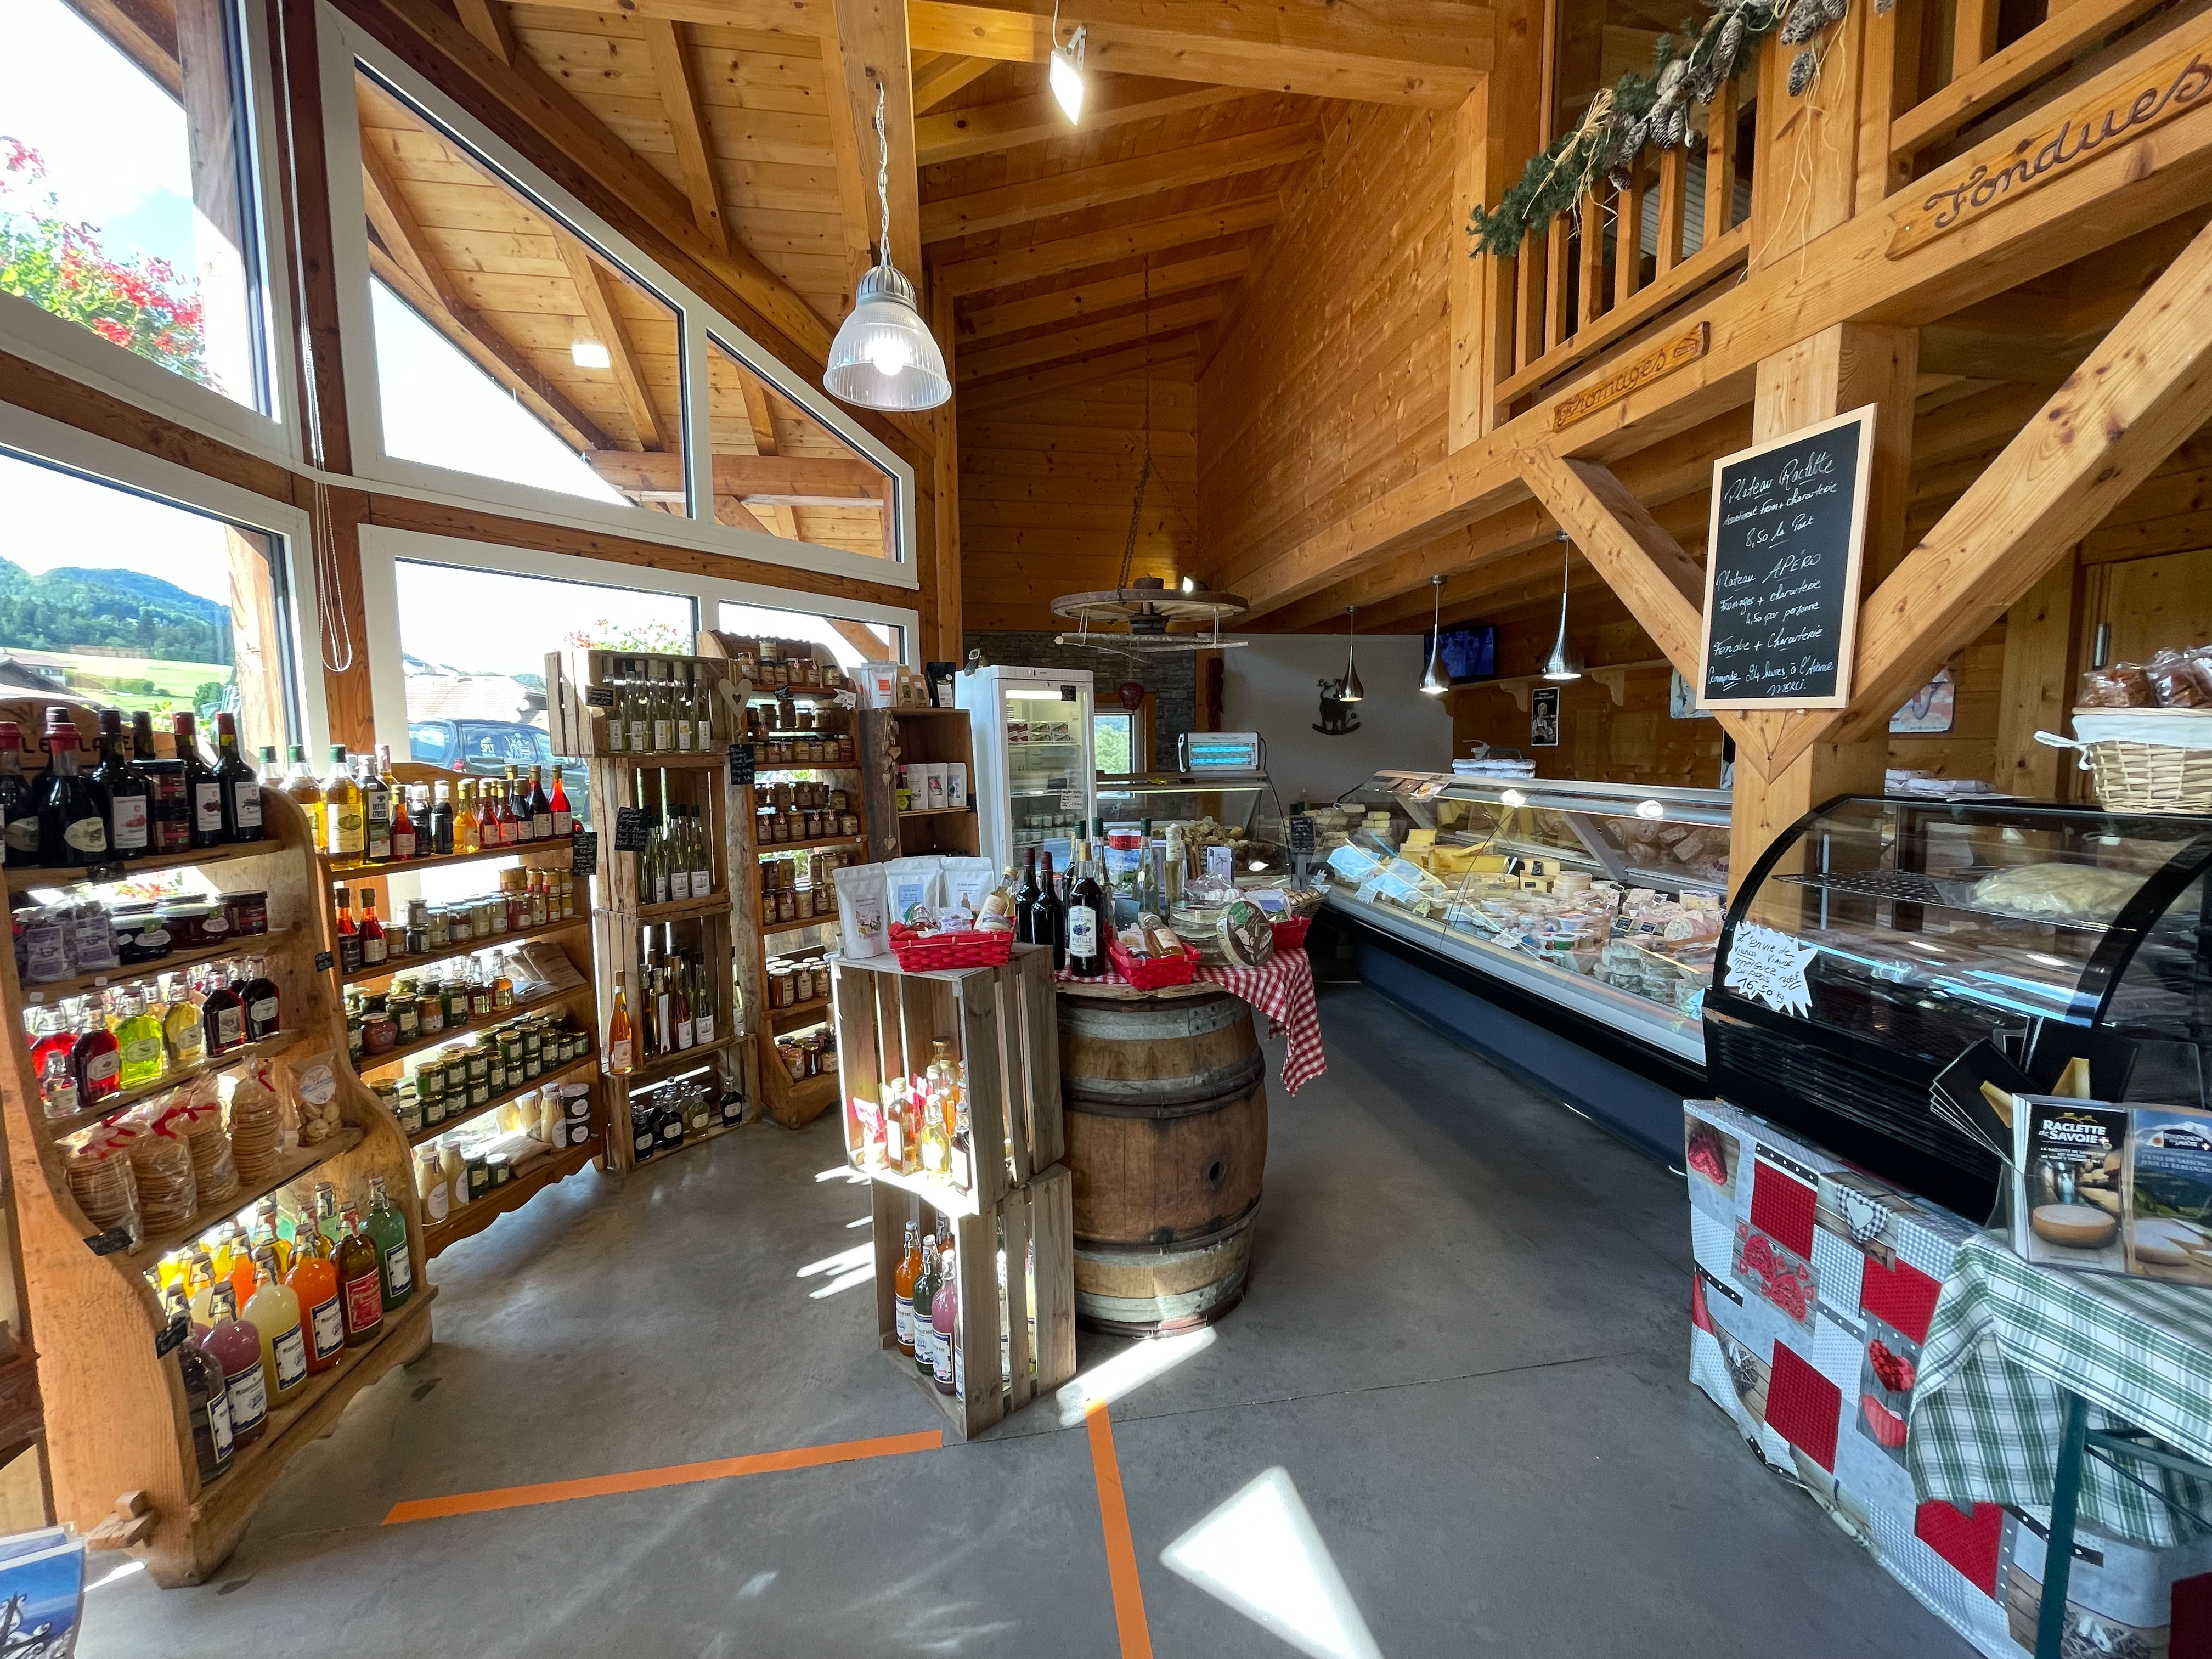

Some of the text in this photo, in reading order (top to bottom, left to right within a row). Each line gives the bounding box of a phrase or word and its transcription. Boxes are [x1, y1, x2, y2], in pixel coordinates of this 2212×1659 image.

[1922, 54, 2212, 228] Fondues
[1556, 347, 1667, 427] Fromages
[1724, 451, 1835, 504] Plateau Raclette
[1716, 569, 1756, 591] Plateau
[1779, 946, 1795, 958] de
[2042, 1119, 2107, 1136] RACLETTE
[2049, 1130, 2098, 1144] SAVOIE
